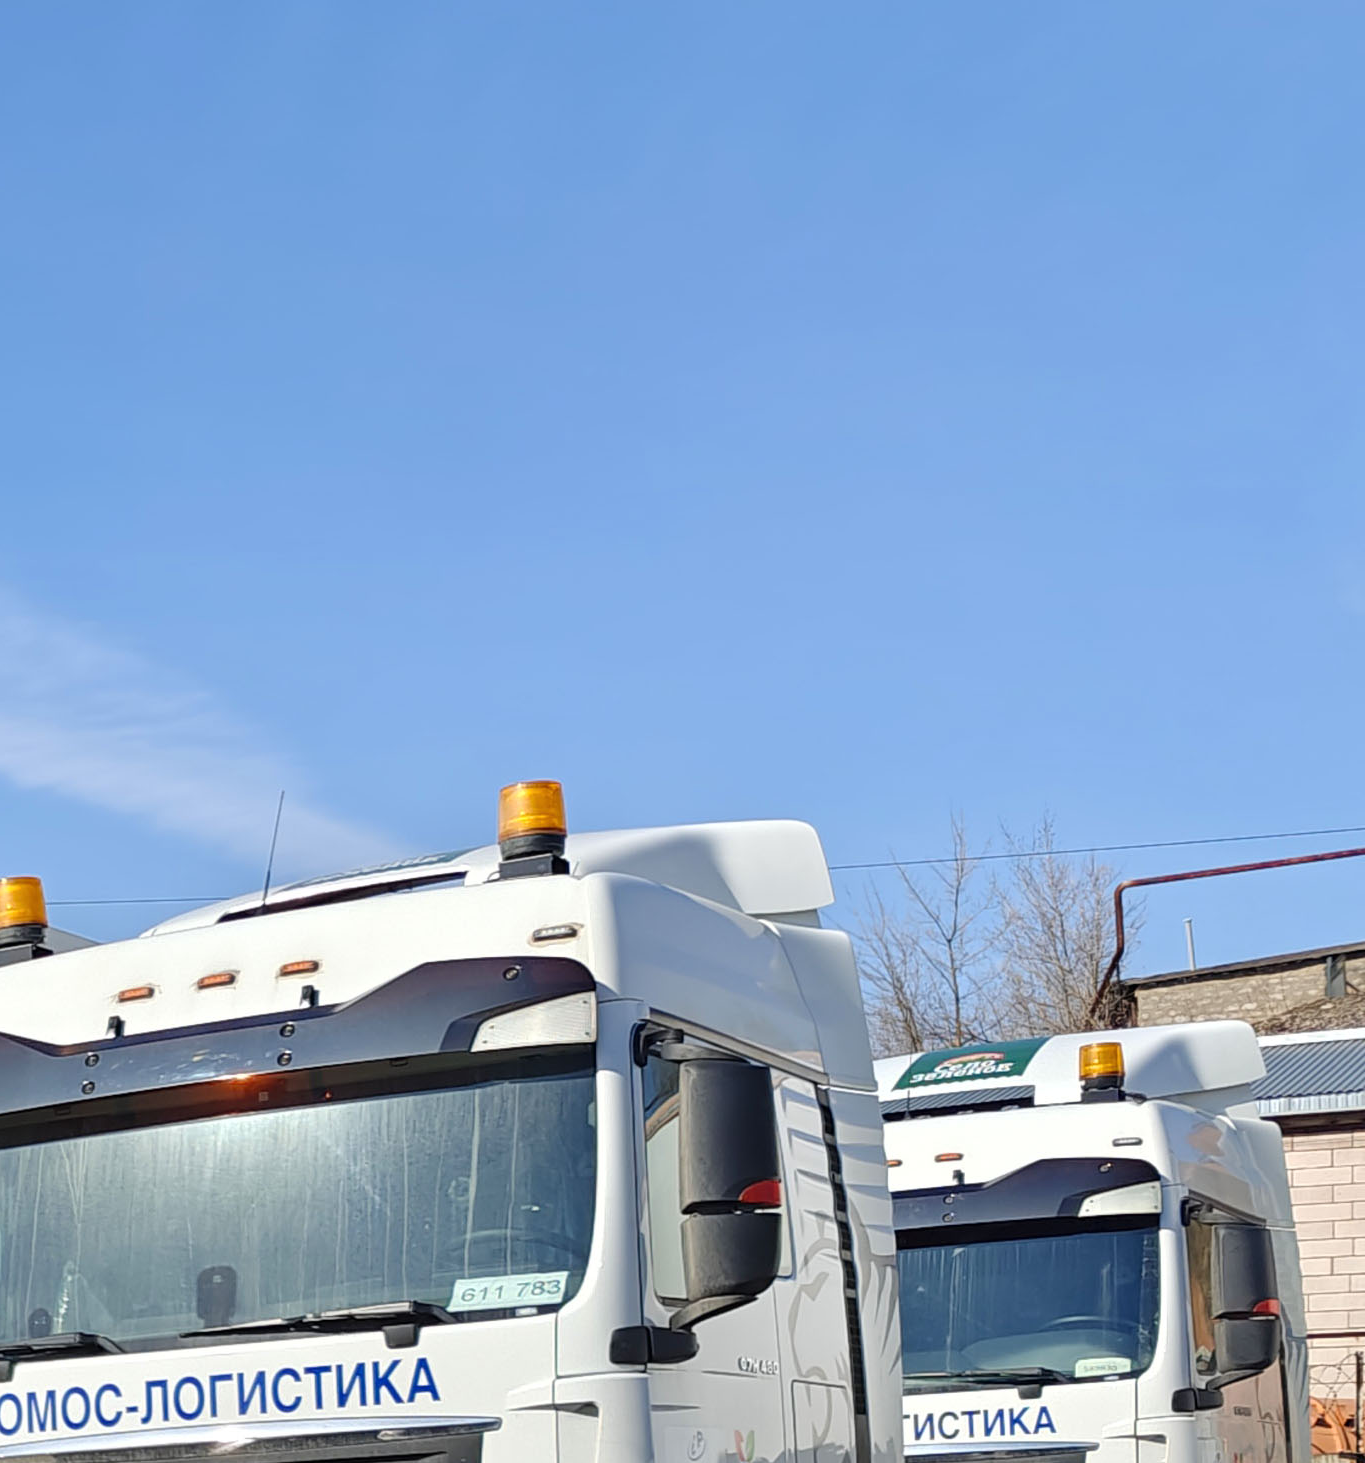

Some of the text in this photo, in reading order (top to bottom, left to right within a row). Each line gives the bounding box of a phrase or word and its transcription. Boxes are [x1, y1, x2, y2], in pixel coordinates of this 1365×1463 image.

[461, 1279, 561, 1302] 611 783
[903, 1405, 1057, 1441] ИСТИКА
